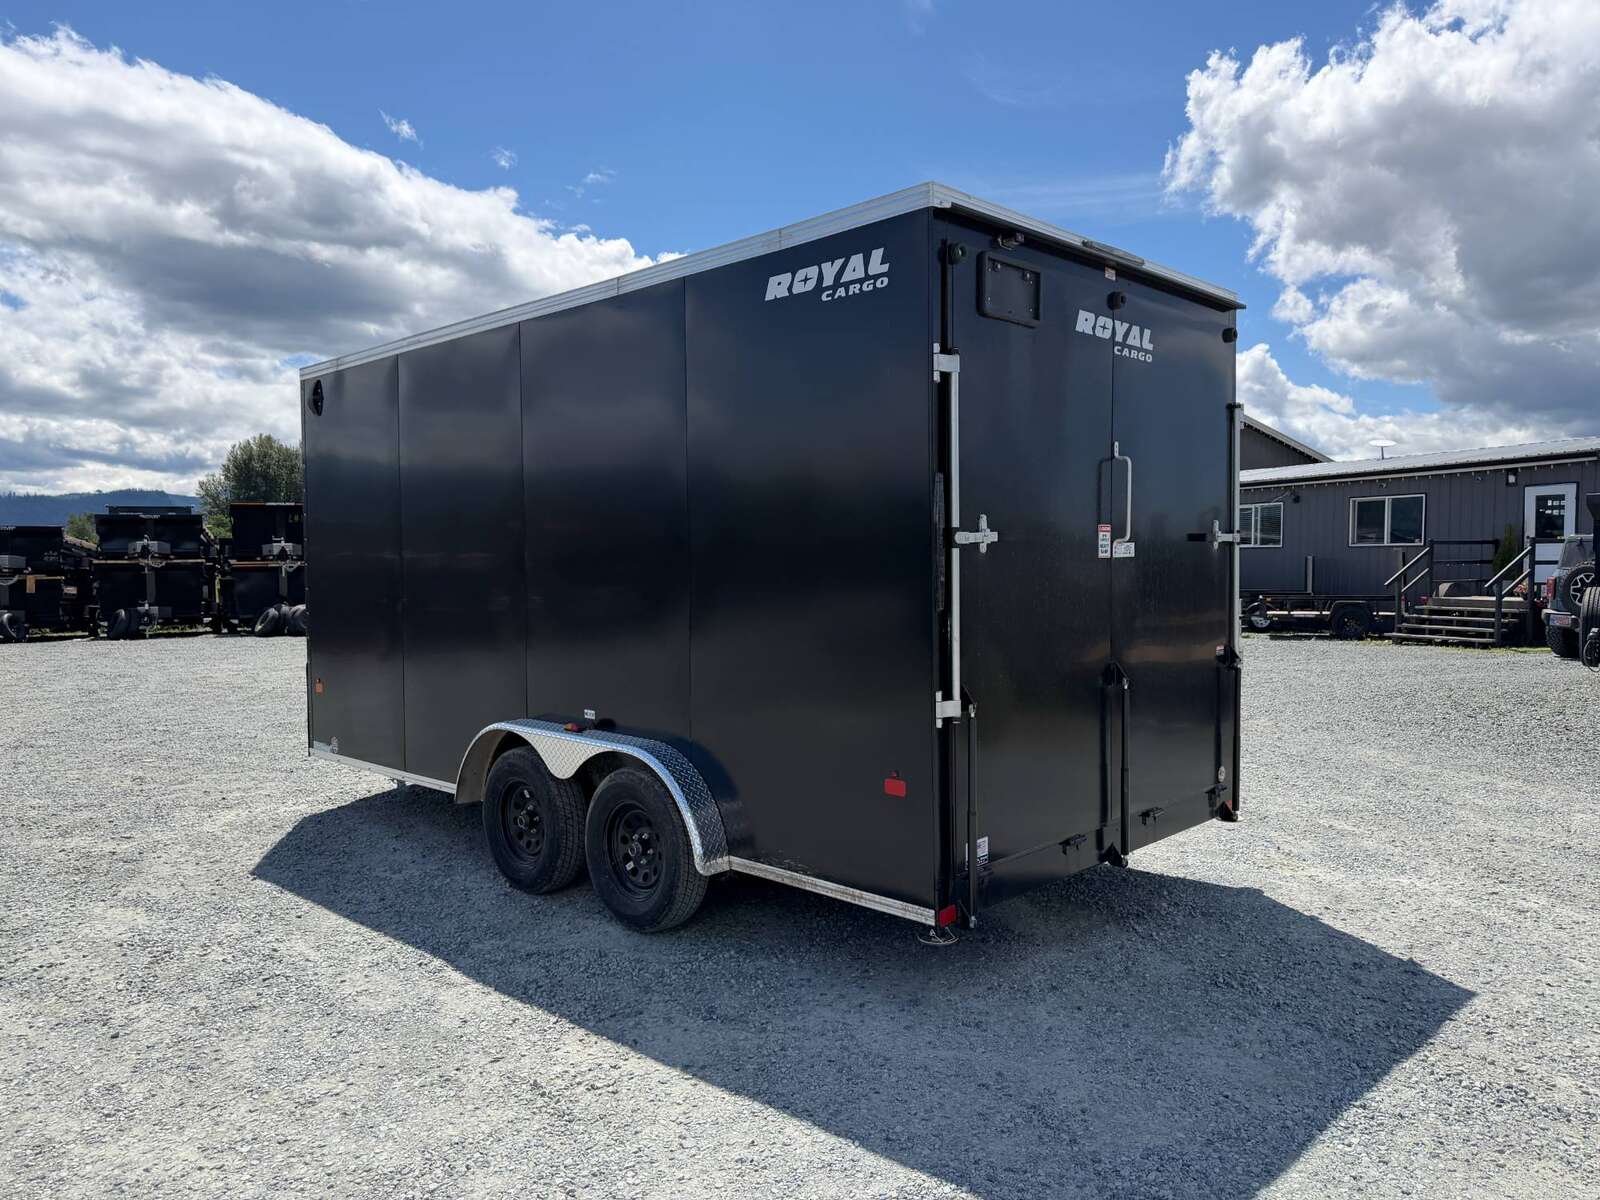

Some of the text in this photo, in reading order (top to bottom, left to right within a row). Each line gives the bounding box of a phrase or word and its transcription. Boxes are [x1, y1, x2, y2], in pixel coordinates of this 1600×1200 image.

[765, 247, 890, 301] ROYAL
[821, 276, 889, 302] CARGO
[1075, 309, 1154, 350] ROYAL
[1114, 346, 1153, 363] CARGO
